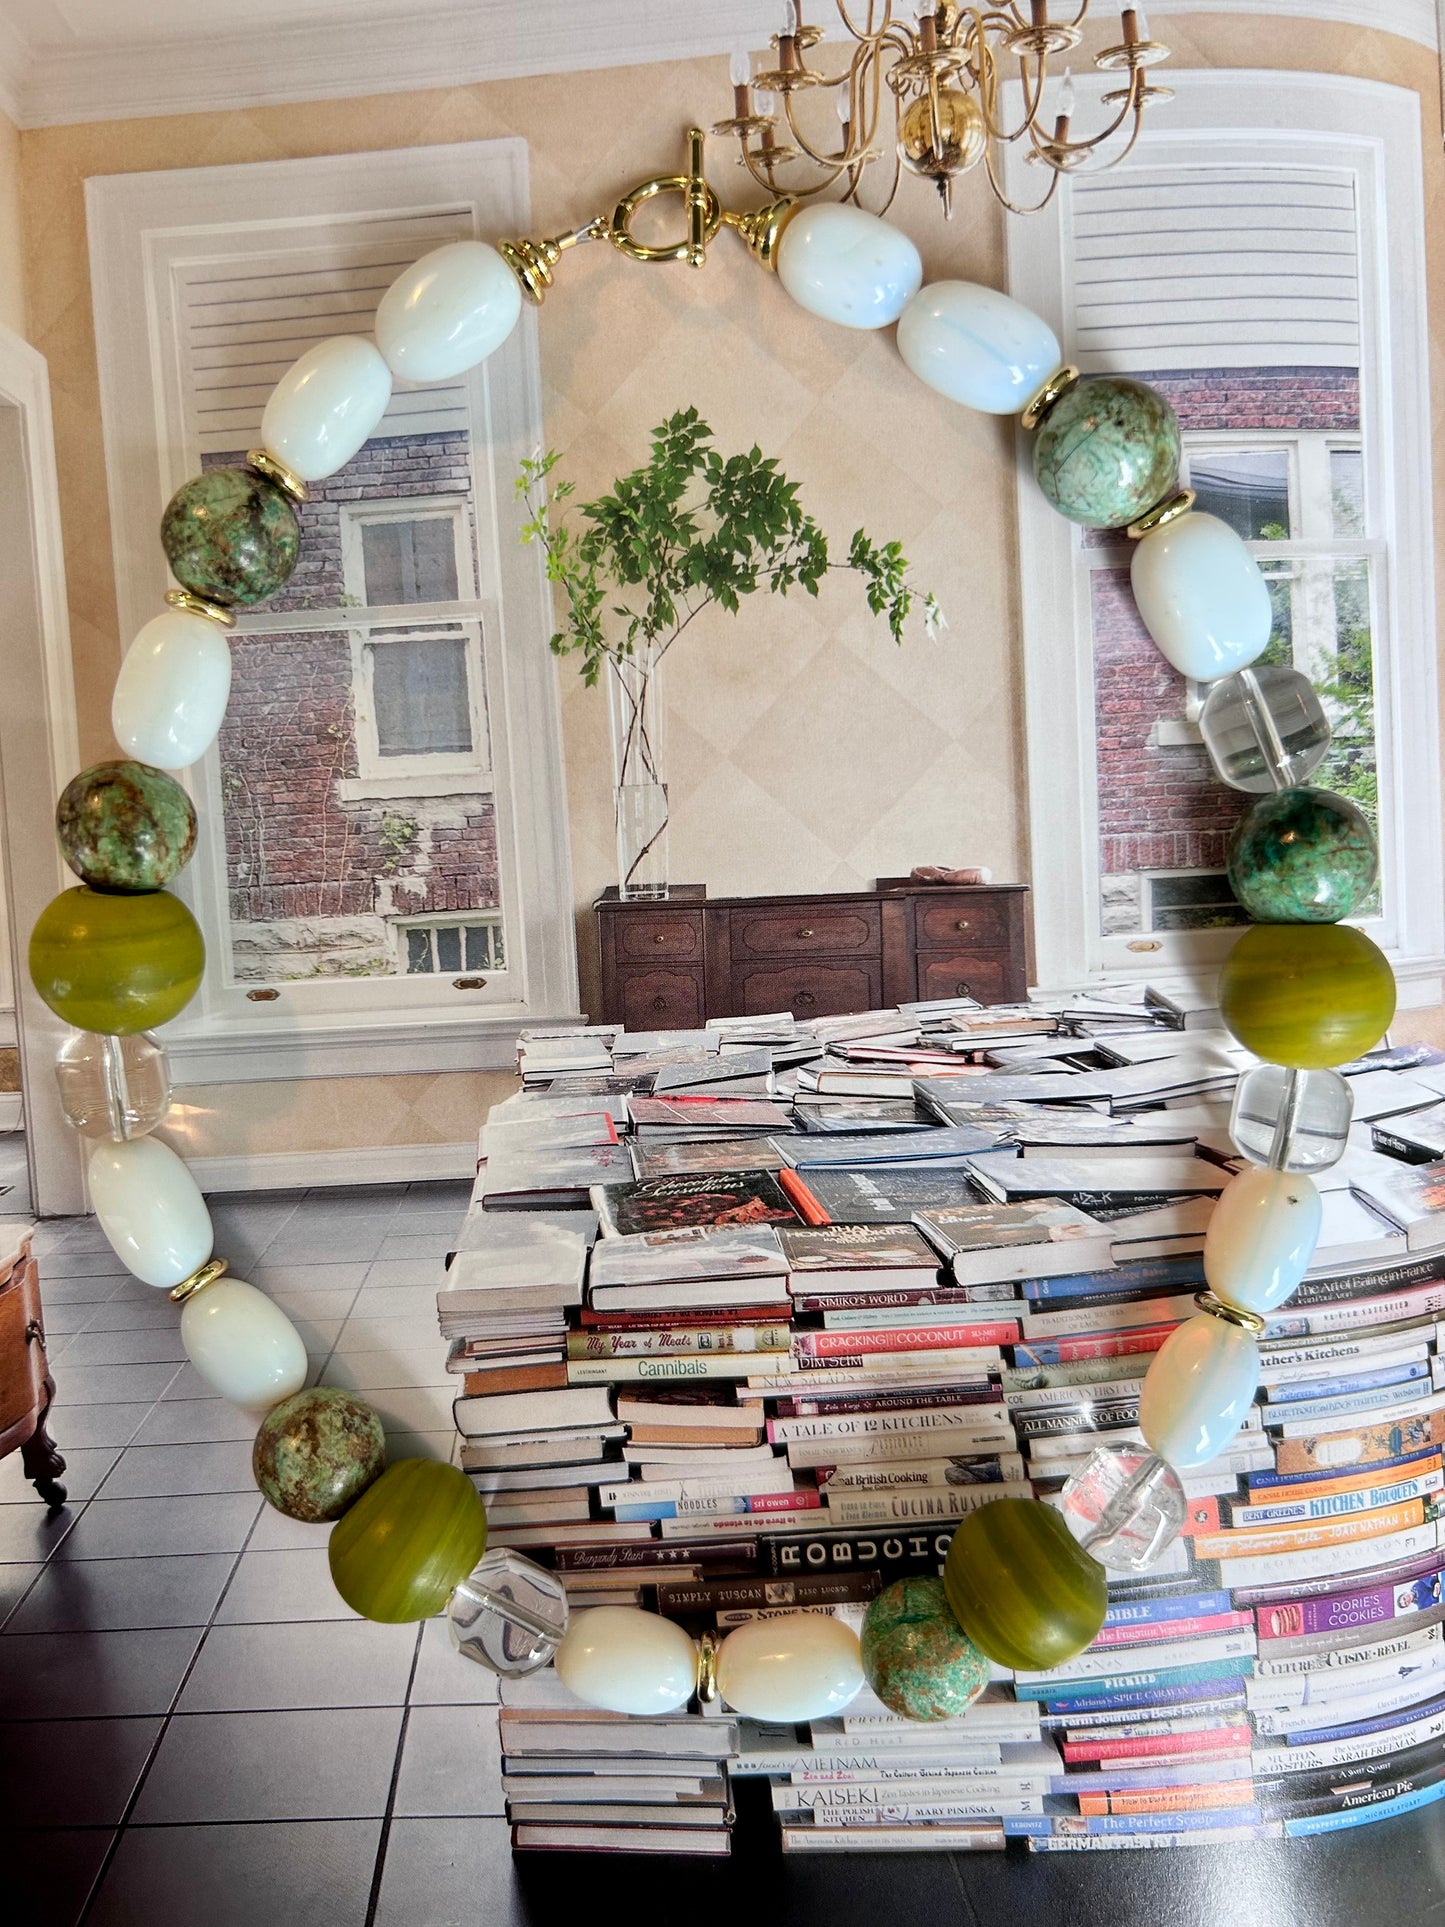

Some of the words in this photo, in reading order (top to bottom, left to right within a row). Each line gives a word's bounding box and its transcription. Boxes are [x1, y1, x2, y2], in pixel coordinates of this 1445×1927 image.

[1297, 1284, 1320, 1297] The
[1321, 1281, 1340, 1294] Art
[1339, 1279, 1352, 1291] of
[1353, 1274, 1389, 1287] Eating
[1388, 1270, 1400, 1280] in
[1399, 1262, 1434, 1279] France
[818, 1295, 866, 1308] KIMIKO'S
[868, 1293, 908, 1306] WORLD
[586, 1336, 606, 1354] My
[610, 1335, 638, 1359] Year
[643, 1338, 653, 1349] of
[658, 1332, 692, 1348] Meats
[819, 1333, 887, 1349] CRACKING
[896, 1329, 965, 1346] COCONUT
[1304, 1345, 1360, 1361] Kitchens
[637, 1360, 708, 1378] Cannibals
[800, 1356, 826, 1370] DIM
[828, 1355, 864, 1368] SUM
[1094, 1385, 1122, 1398] FIRST
[875, 1398, 913, 1408] AROUND
[916, 1396, 933, 1405] THE
[936, 1395, 962, 1403] TABLE
[778, 1427, 788, 1438] A
[791, 1422, 833, 1437] TALE
[838, 1420, 860, 1433] OF
[863, 1419, 878, 1432] 12
[882, 1412, 963, 1431] KITCHENS
[1024, 1418, 1047, 1432] ALL
[1099, 1410, 1115, 1423] OF
[856, 1471, 888, 1486] British
[889, 1470, 929, 1486] Cooking
[677, 1498, 719, 1510] NOODLES
[753, 1499, 765, 1508] sri
[766, 1498, 790, 1508] owen
[892, 1496, 944, 1517] CUCINA
[949, 1492, 1008, 1513] RUST
[1309, 1492, 1365, 1517] KITCHEN
[1370, 1478, 1419, 1507] BOUQUETS
[1244, 1511, 1265, 1520] BERT
[1265, 1506, 1305, 1519] GREENE'S
[1328, 1525, 1357, 1539] JOAN
[1359, 1516, 1399, 1534] NATHAN
[573, 1549, 618, 1568] Burgundy
[619, 1547, 646, 1562] Stars
[668, 1591, 712, 1604] SIMPLY
[718, 1588, 762, 1601] TUSCAN
[1332, 1594, 1380, 1613] DORIE'S
[1106, 1606, 1152, 1621] BIBLE
[1328, 1606, 1385, 1627] COOKIES
[1097, 1630, 1115, 1642] The
[1116, 1626, 1158, 1640] Fragrant
[1158, 1620, 1202, 1637] Vegetable
[1257, 1659, 1316, 1676] CULTURE
[1325, 1651, 1373, 1668] CUISINE
[1377, 1640, 1411, 1657] REVEL
[1073, 1696, 1113, 1708] Adriana's
[1113, 1692, 1143, 1705] SPICE
[1144, 1687, 1190, 1700] CARAVAN
[1061, 1717, 1094, 1728] Farm
[1095, 1711, 1150, 1725] Journal's
[1150, 1704, 1205, 1720] Best-Ever
[1207, 1700, 1236, 1713] Pies
[1267, 1750, 1316, 1764] MUTTON
[1332, 1750, 1369, 1764] SARAH
[1370, 1737, 1418, 1757] FREEMAN
[801, 1756, 879, 1771] VIETNAM
[1270, 1759, 1324, 1773] OYSTERS
[879, 1769, 893, 1779] The
[894, 1768, 918, 1778] Culture
[920, 1768, 943, 1778] Behind
[943, 1767, 973, 1777] Japanese
[973, 1766, 998, 1776] Cuisine
[1339, 1770, 1347, 1780] A
[796, 1787, 880, 1808] KAISEKI
[881, 1789, 898, 1799] Zen
[931, 1786, 966, 1798] Japanese
[965, 1784, 1001, 1796] Cooking
[1341, 1788, 1396, 1808] American
[1396, 1780, 1414, 1797] Pie
[821, 1808, 841, 1817] THE
[842, 1807, 875, 1816] POLISH
[822, 1815, 867, 1824] KITCHEN
[914, 1807, 944, 1817] MARY
[1010, 1821, 1042, 1829] LEBOVITZ
[1102, 1815, 1125, 1829] The
[1128, 1814, 1173, 1828] Perfect
[1174, 1813, 1213, 1828] Scoop
[1307, 1818, 1340, 1831] PERFECT
[1341, 1815, 1358, 1826] PIES
